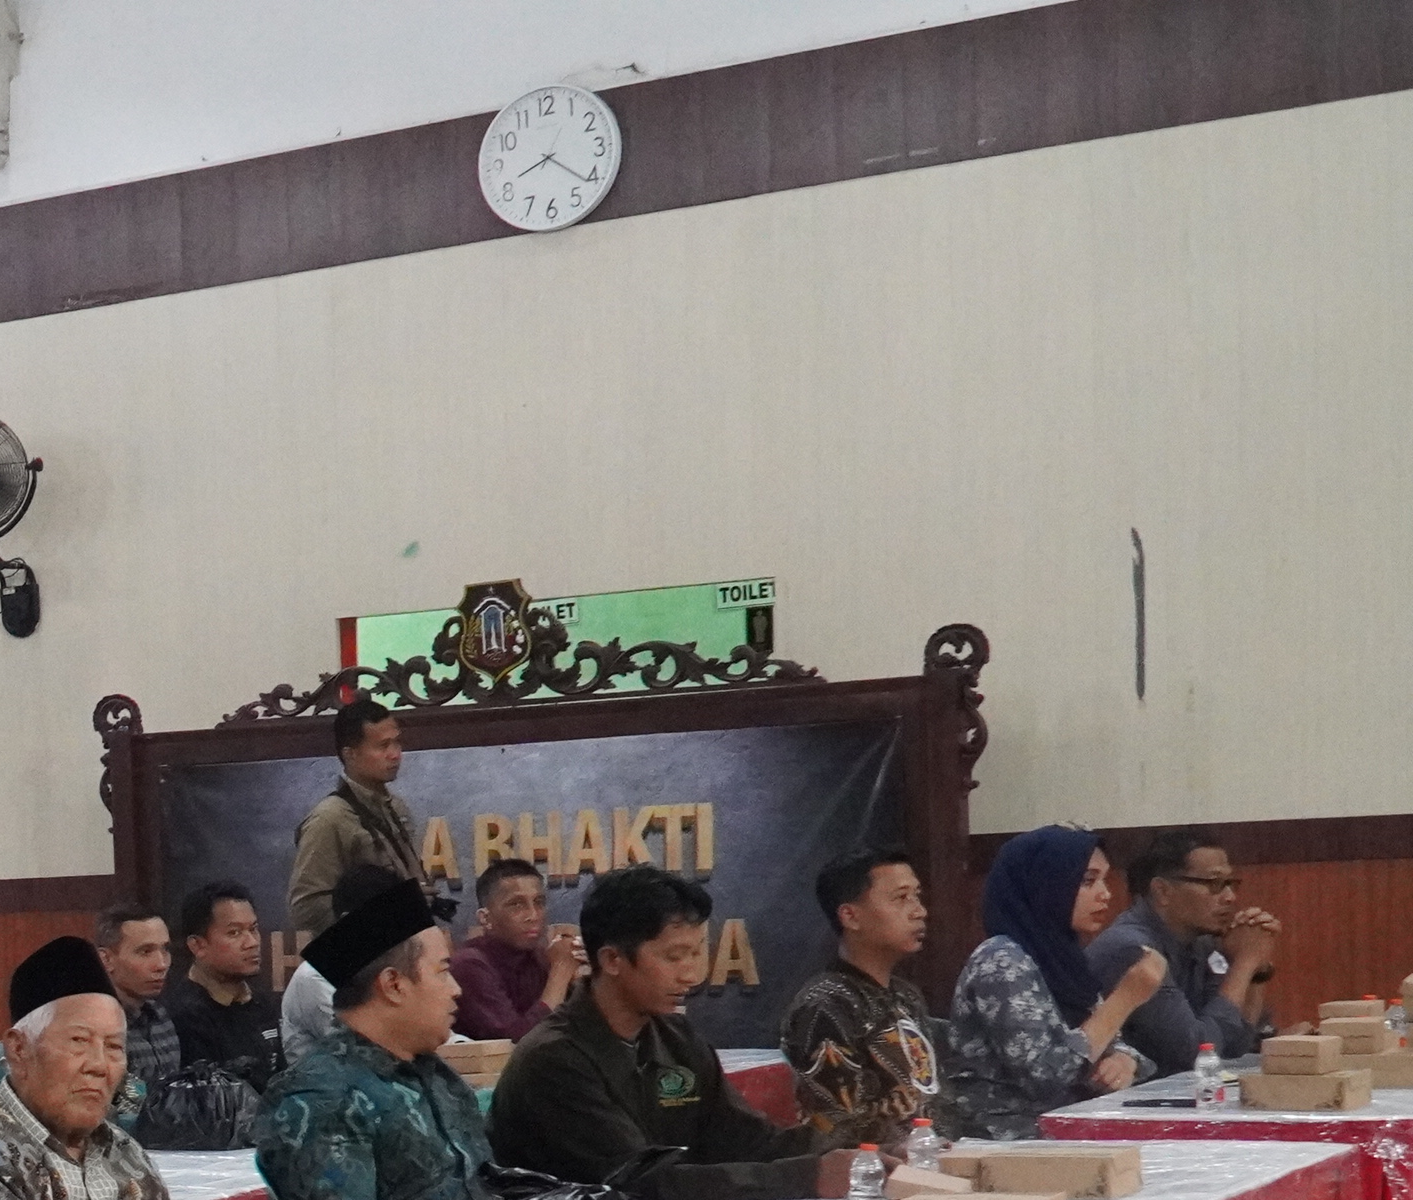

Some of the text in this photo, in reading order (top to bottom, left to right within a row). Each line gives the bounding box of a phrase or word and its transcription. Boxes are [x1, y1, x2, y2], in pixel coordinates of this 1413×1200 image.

[537, 95, 555, 117] 12
[568, 97, 574, 117] 1
[515, 109, 529, 130] 11
[583, 111, 596, 133] 2
[499, 131, 517, 152] 10
[593, 136, 606, 157] 3
[492, 158, 504, 173] 9
[586, 164, 598, 185] 4
[502, 181, 514, 202] 8
[570, 186, 582, 208] 5
[523, 195, 535, 218] 7
[545, 198, 558, 219] 6
[473, 802, 715, 883] BHAKTI
